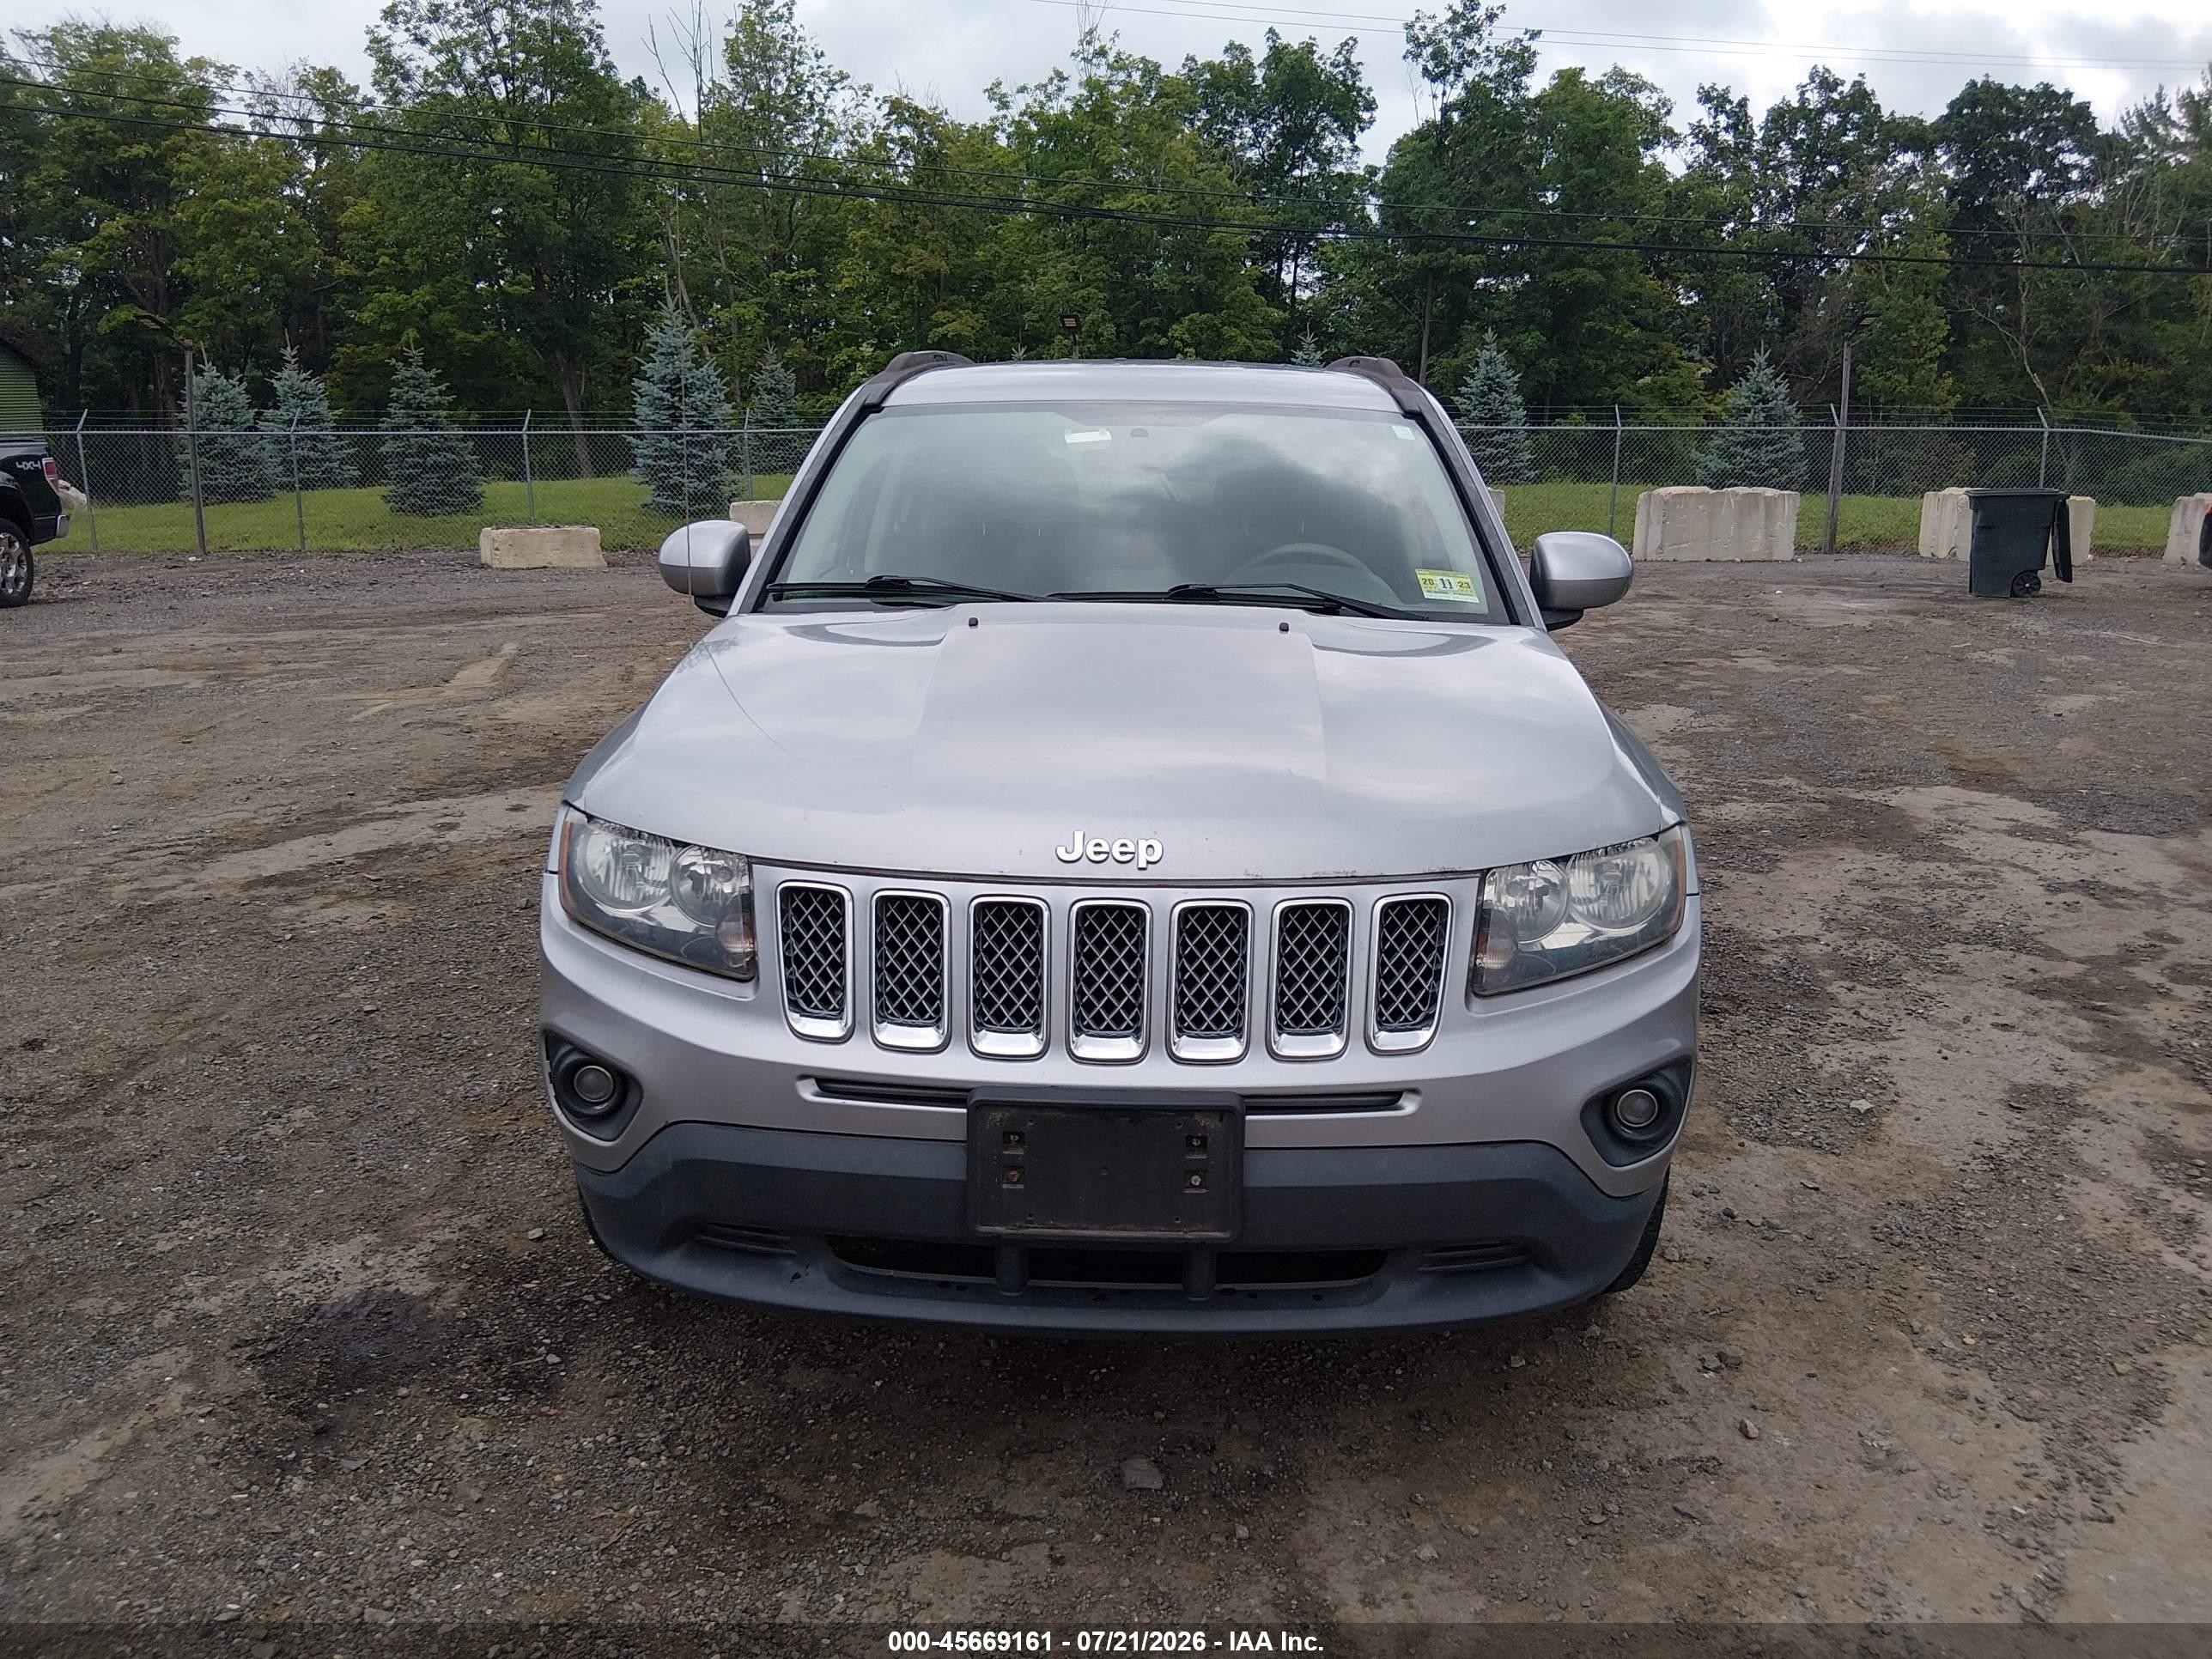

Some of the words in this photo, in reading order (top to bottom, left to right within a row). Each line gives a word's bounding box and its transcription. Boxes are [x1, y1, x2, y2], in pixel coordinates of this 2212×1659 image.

[1440, 578, 1454, 589] 11
[1457, 580, 1471, 589] 23
[1055, 830, 1164, 870] Jeep
